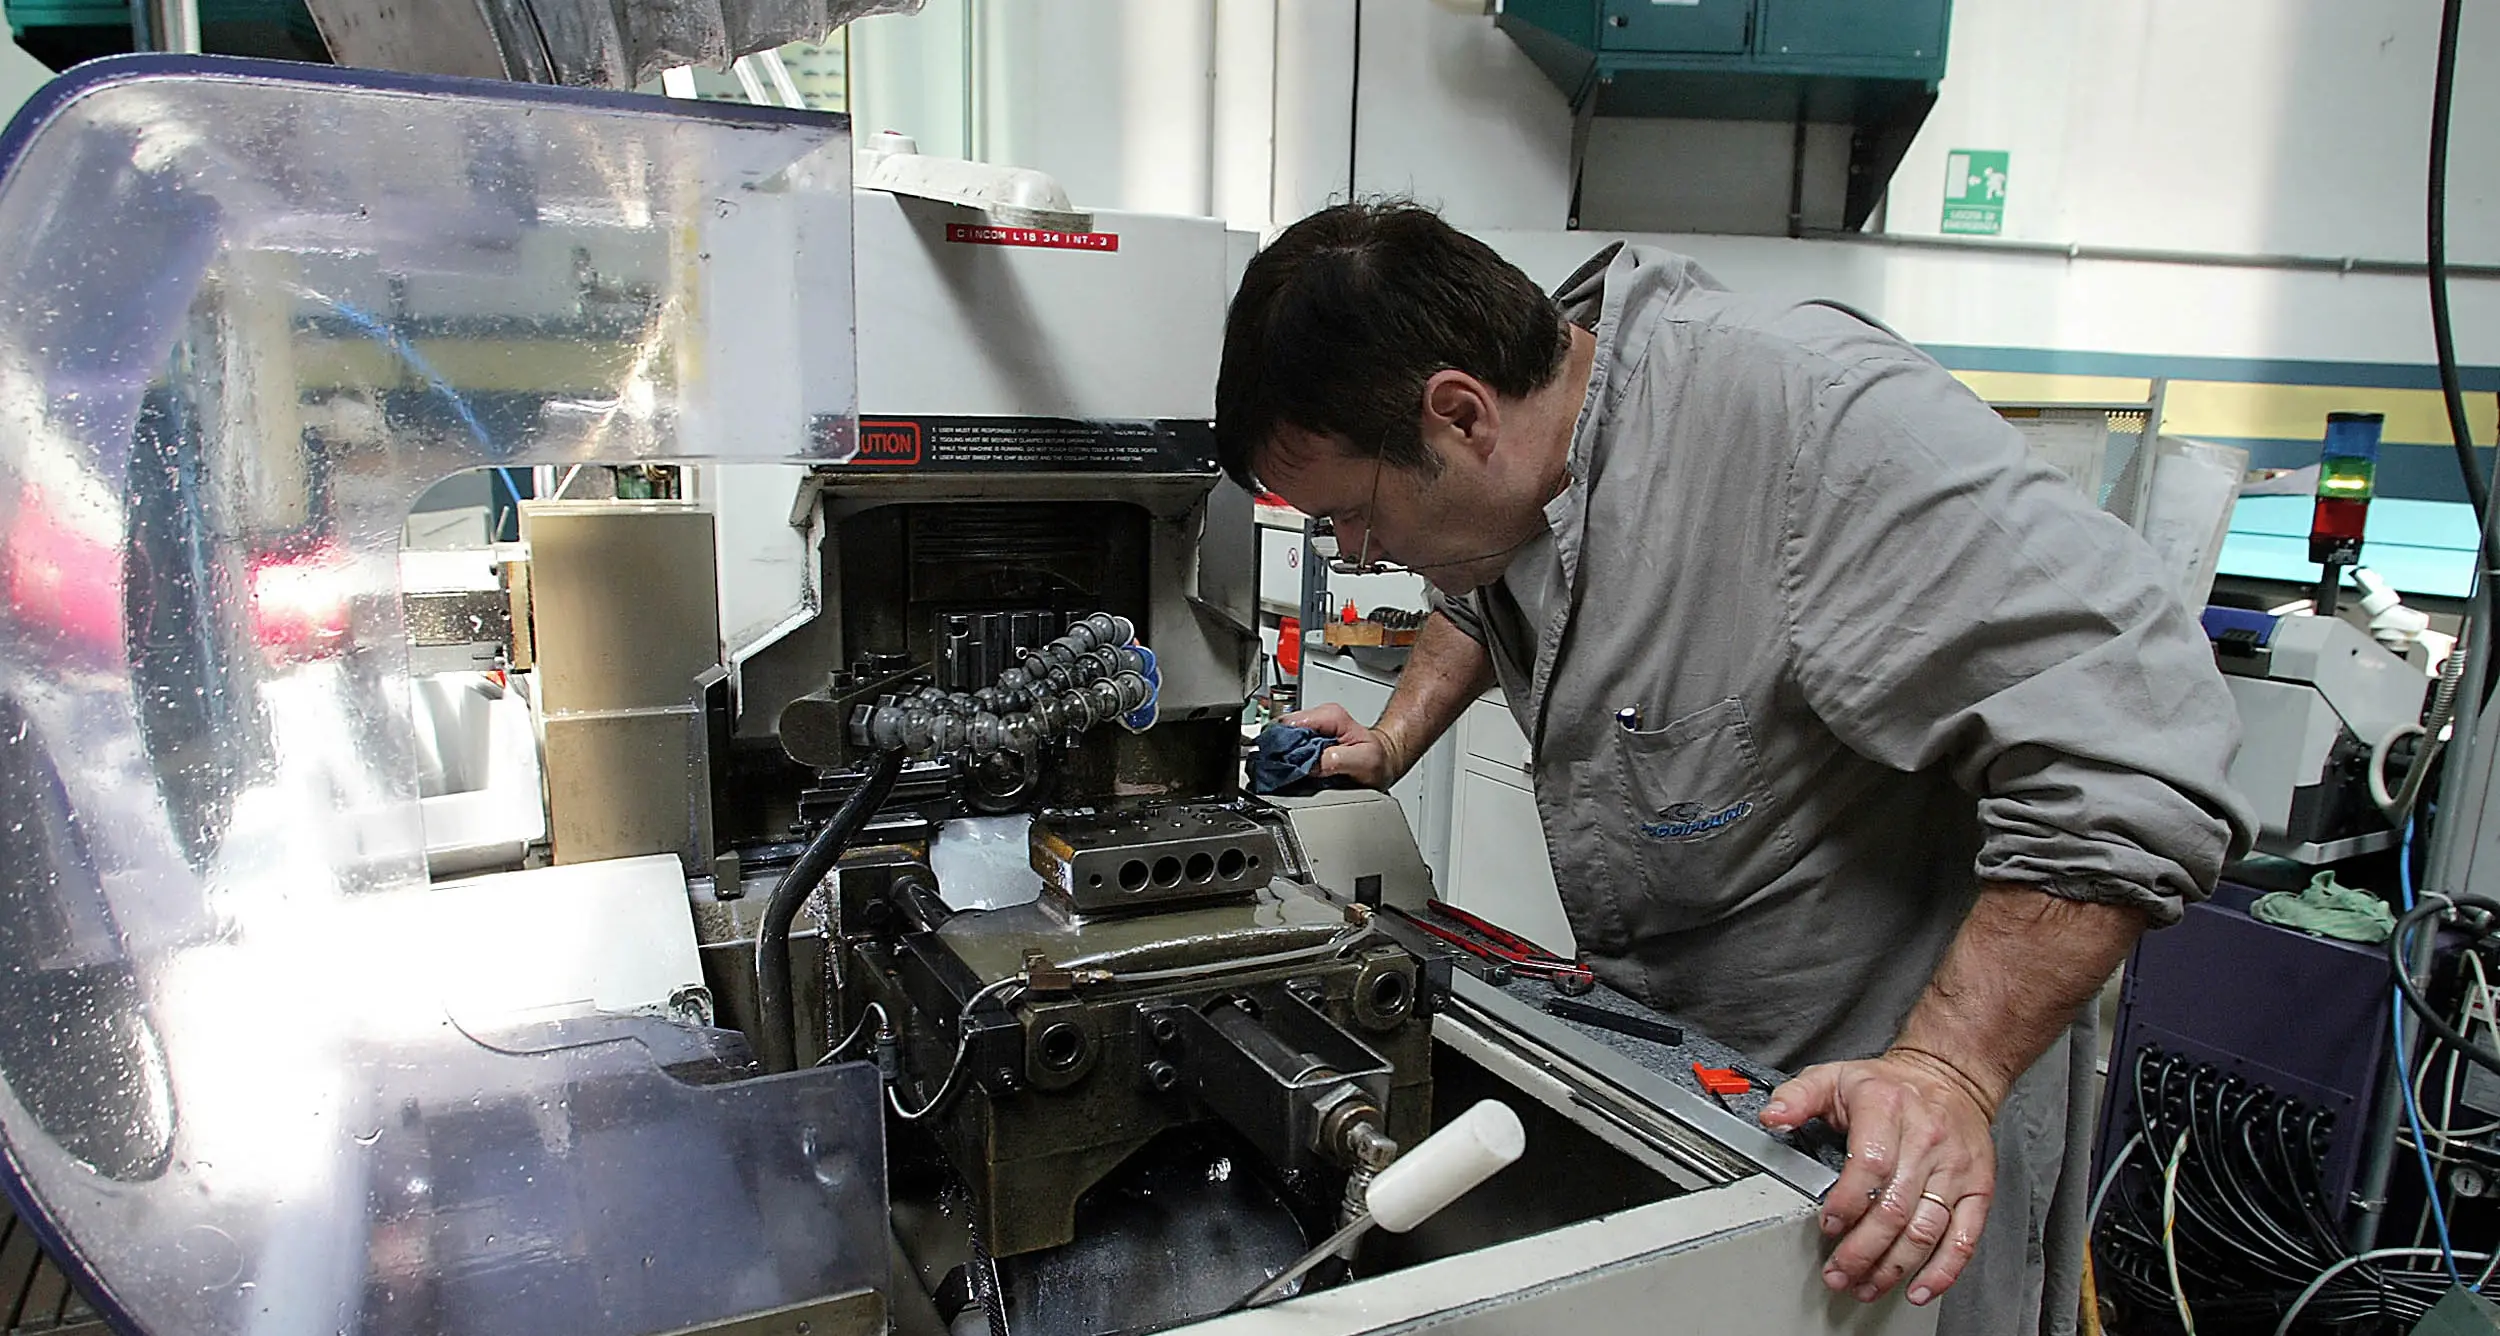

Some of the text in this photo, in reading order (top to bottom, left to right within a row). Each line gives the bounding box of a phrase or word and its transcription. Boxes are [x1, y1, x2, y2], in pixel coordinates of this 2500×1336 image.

[1043, 233, 1059, 243] 34
[1100, 236, 1107, 246] 3
[861, 432, 911, 454] UTION
